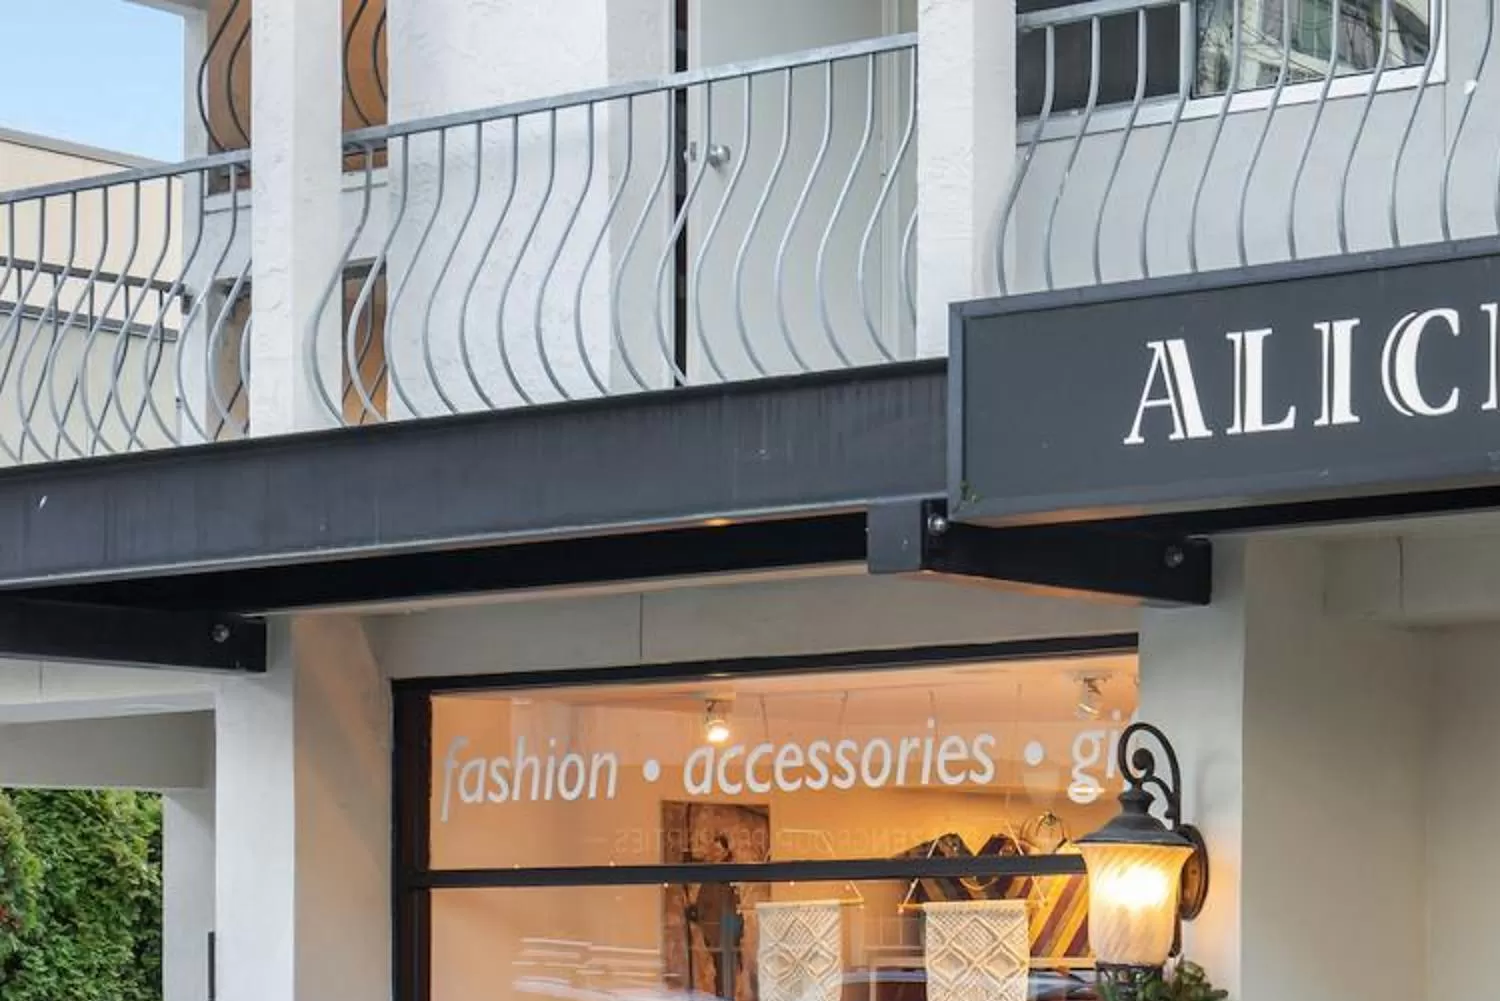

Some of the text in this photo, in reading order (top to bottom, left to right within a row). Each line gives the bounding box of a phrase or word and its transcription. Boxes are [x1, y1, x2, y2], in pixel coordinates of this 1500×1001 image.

[440, 709, 1121, 823] fashion accessories gi
